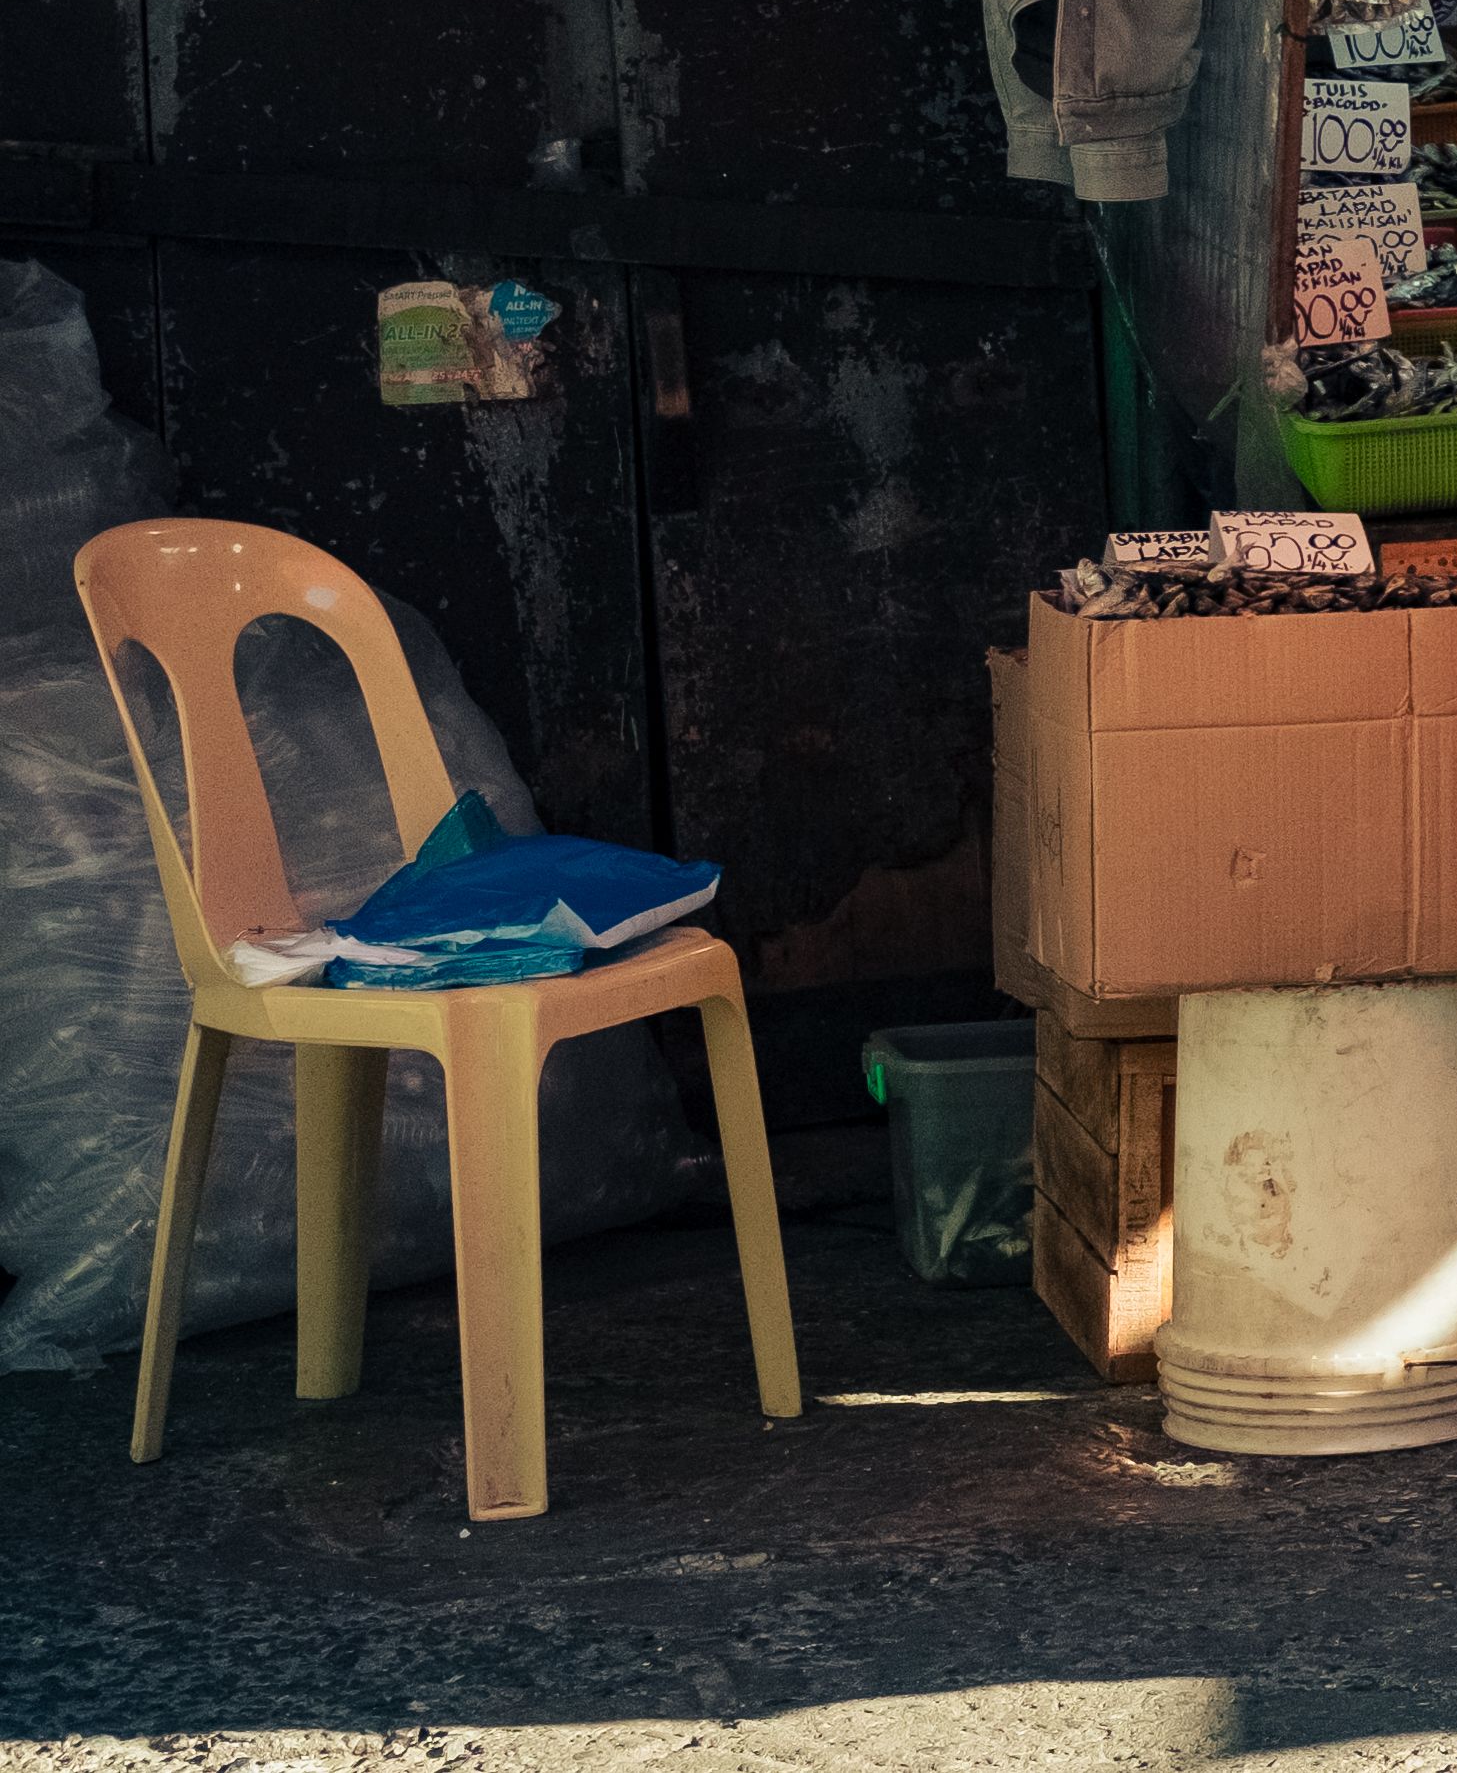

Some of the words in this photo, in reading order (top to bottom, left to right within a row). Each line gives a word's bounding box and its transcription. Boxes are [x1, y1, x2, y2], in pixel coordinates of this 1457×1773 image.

[1311, 82, 1368, 98] TULIS
[1300, 186, 1384, 205] BATAAN
[1320, 199, 1397, 217] LAPAD
[385, 325, 440, 341] ALL-IN
[1114, 532, 1151, 547] SAN
